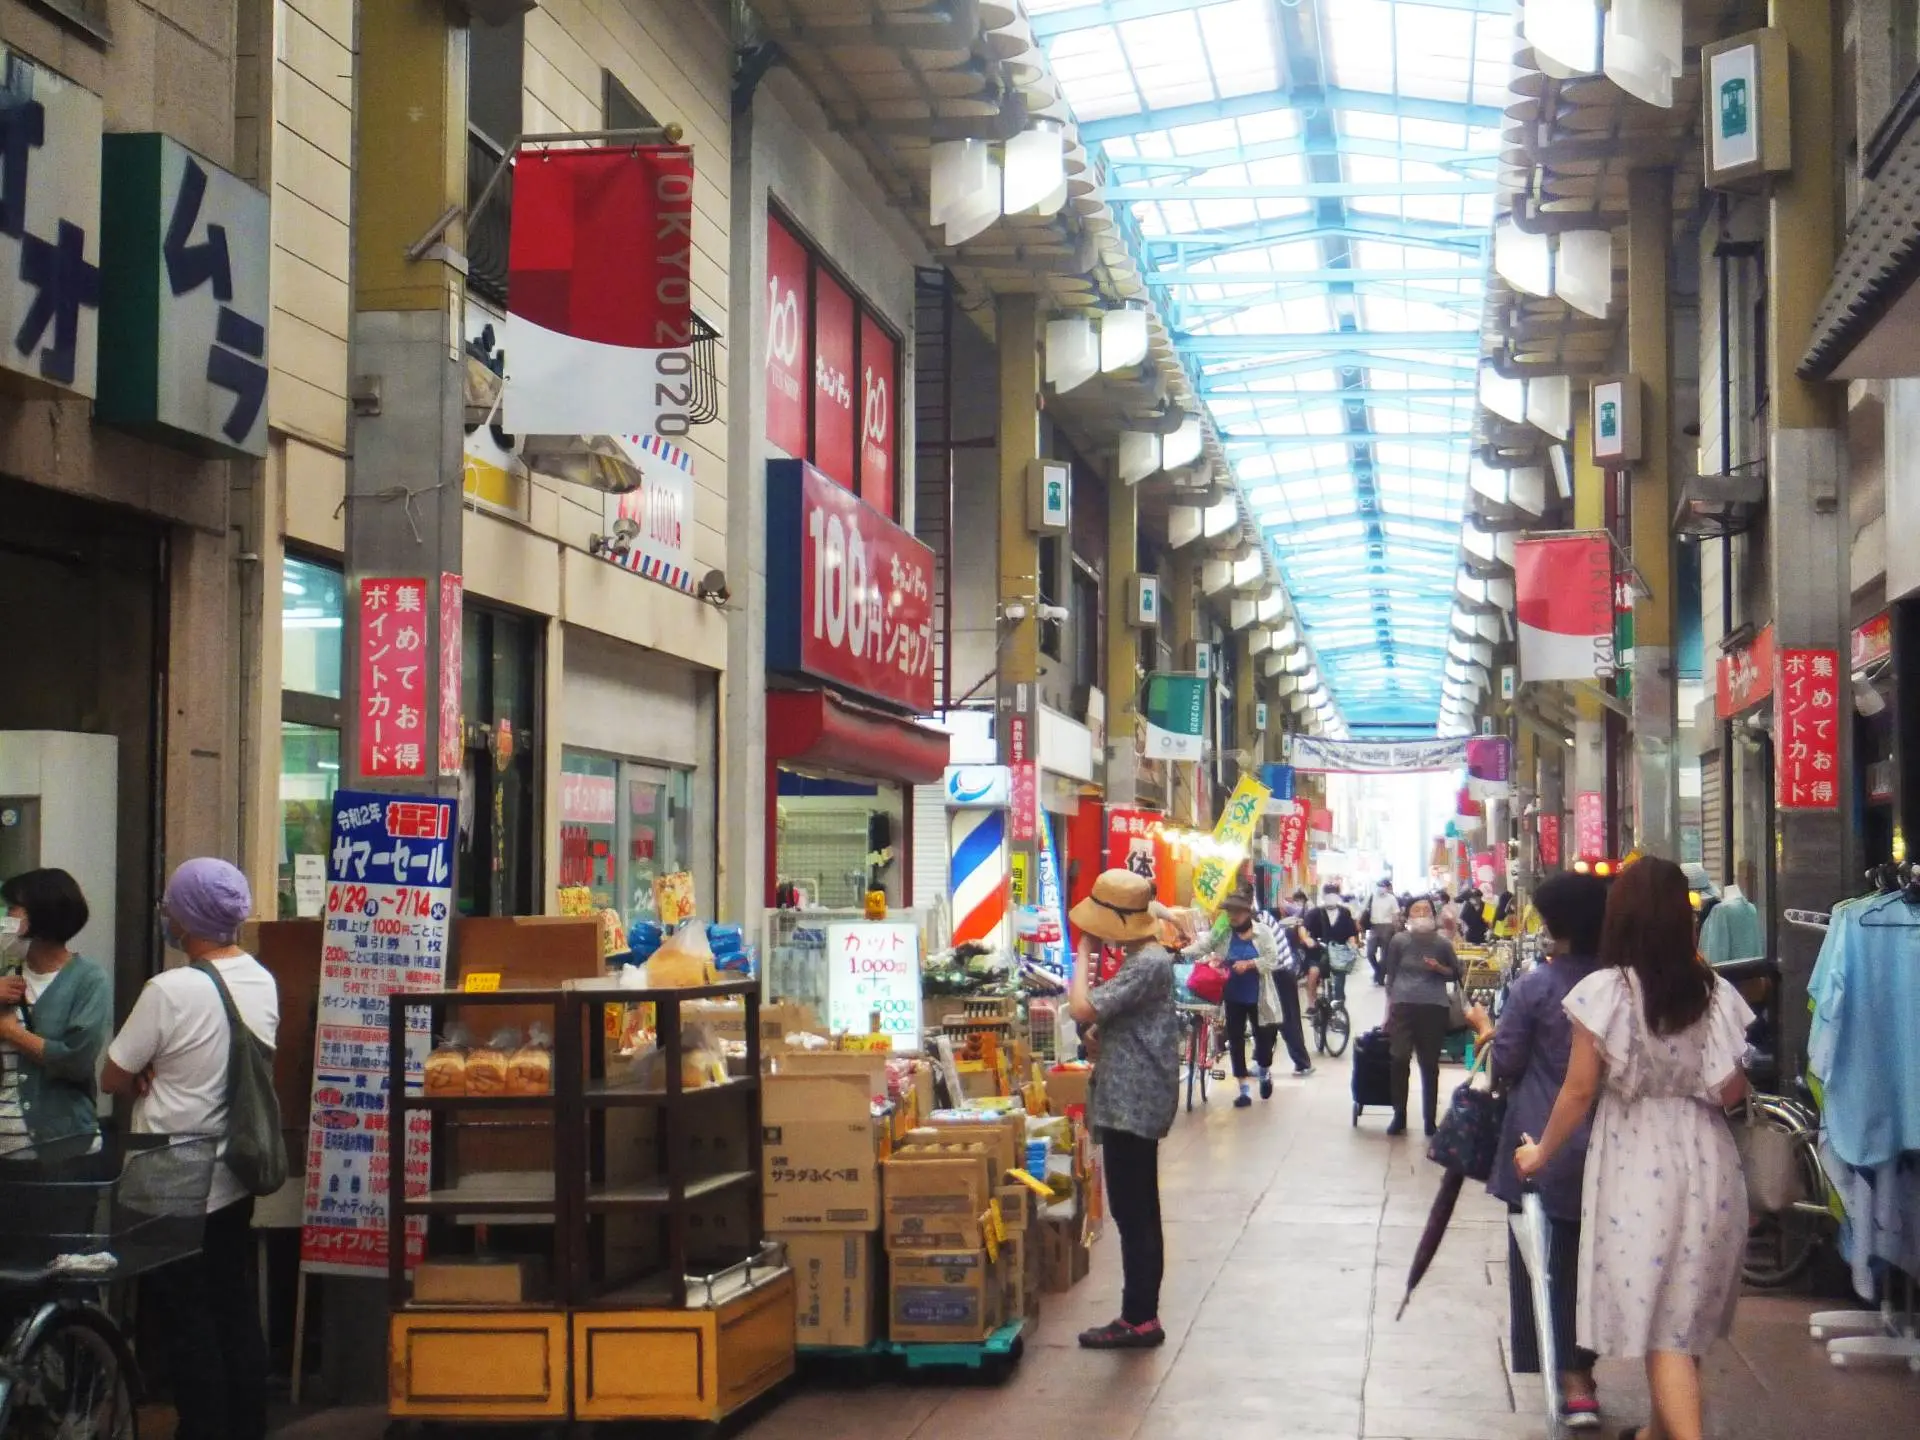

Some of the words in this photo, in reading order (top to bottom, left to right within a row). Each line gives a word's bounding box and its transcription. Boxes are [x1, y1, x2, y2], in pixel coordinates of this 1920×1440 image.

[164, 156, 268, 443] ムラ
[655, 148, 694, 305] TOKYO
[655, 320, 692, 437] 2020
[364, 584, 390, 771] ポイントカード
[395, 585, 421, 770] 集めてお得
[1785, 654, 1808, 803] ポイントカード
[1811, 655, 1833, 802] 集めてお得
[333, 836, 448, 884] サマーセール
[337, 803, 382, 831] 令和2年
[386, 801, 451, 839] 福引
